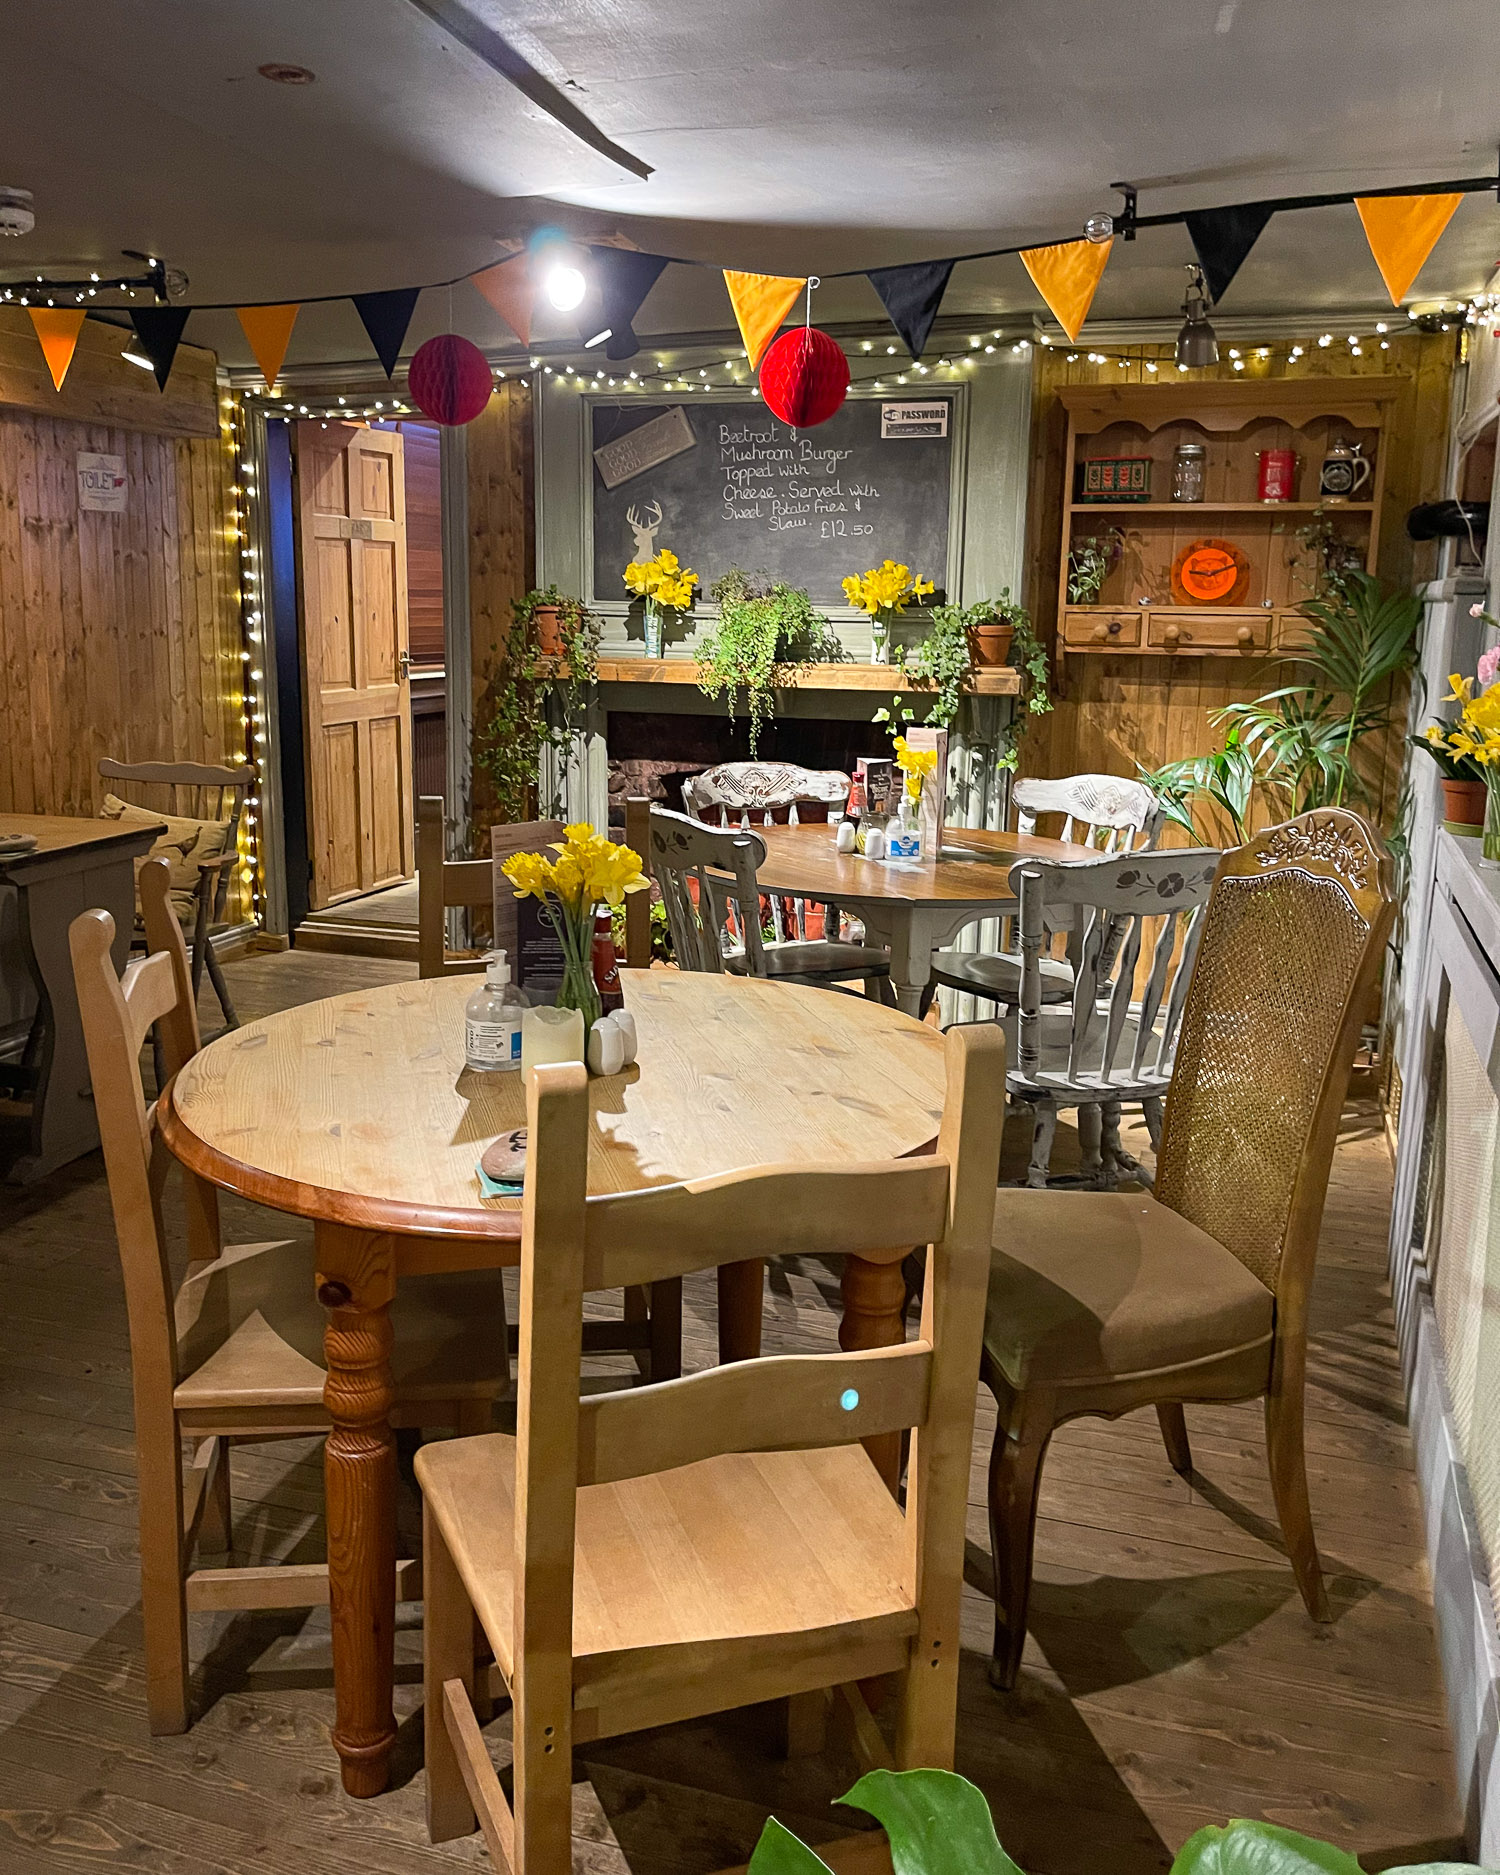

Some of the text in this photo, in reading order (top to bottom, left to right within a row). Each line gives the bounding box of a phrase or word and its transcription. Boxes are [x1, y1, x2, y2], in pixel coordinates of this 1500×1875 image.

[901, 409, 946, 420] PASSWORD
[719, 422, 779, 445] Beetroot
[720, 439, 853, 474] Mushroom Burger
[720, 461, 775, 487] Topped
[788, 479, 844, 499] Served
[721, 502, 765, 520] Sweet
[772, 499, 810, 516] Potato
[820, 519, 874, 538] £12.50
